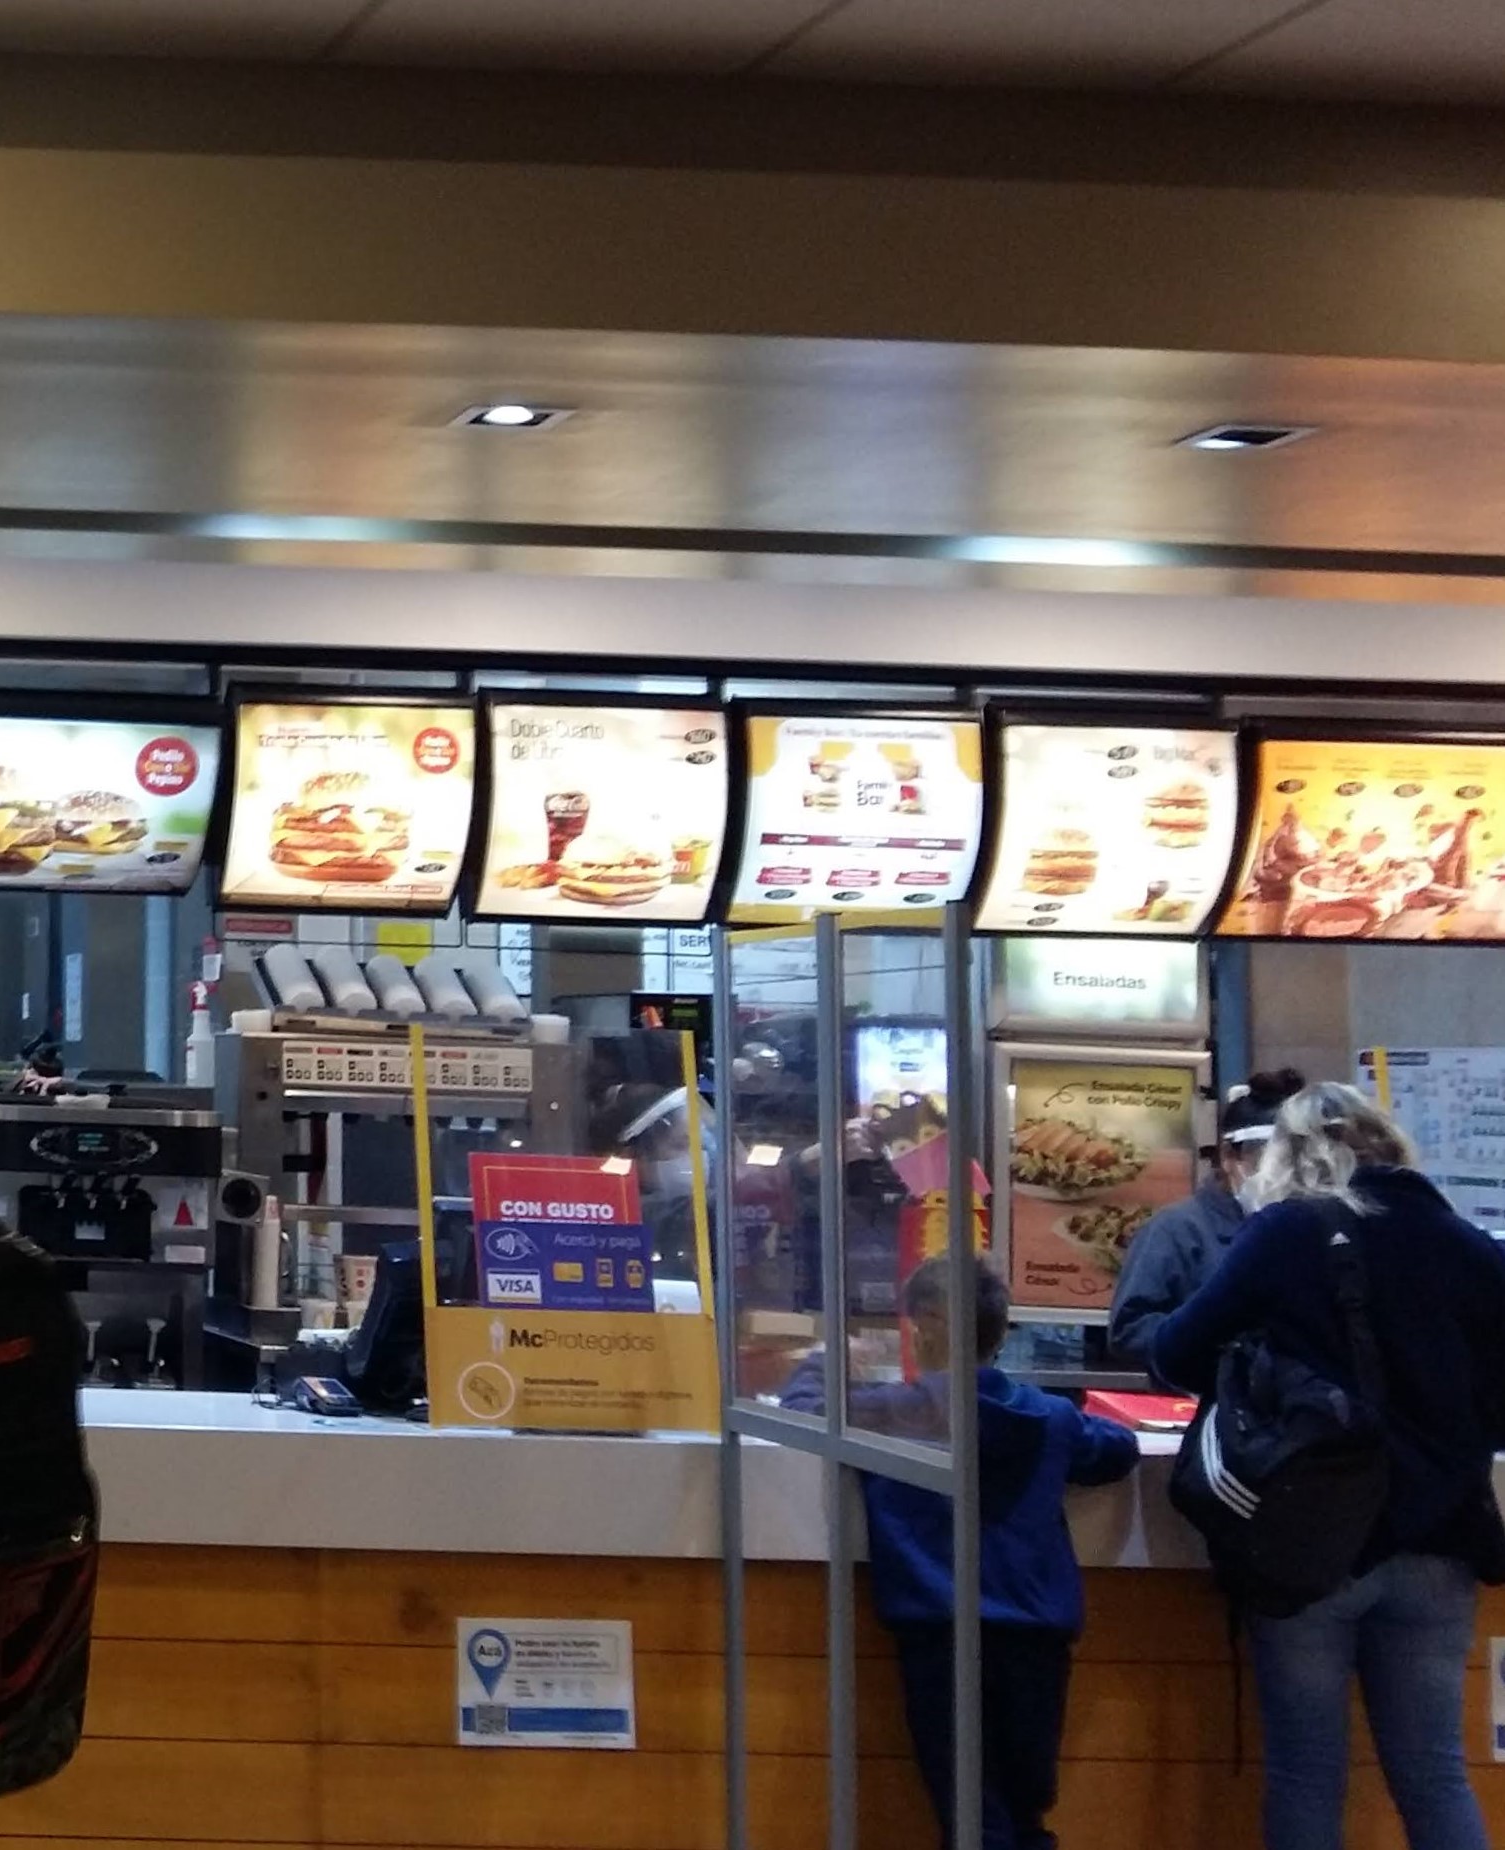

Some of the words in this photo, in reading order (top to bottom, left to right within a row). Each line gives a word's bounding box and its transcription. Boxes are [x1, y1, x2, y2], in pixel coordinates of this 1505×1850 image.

[1053, 971, 1147, 990] Ensaladas
[500, 1200, 543, 1217] CON
[547, 1202, 615, 1220] GUSTO
[495, 1277, 536, 1294] VISA
[509, 1328, 657, 1355] McProtegidos
